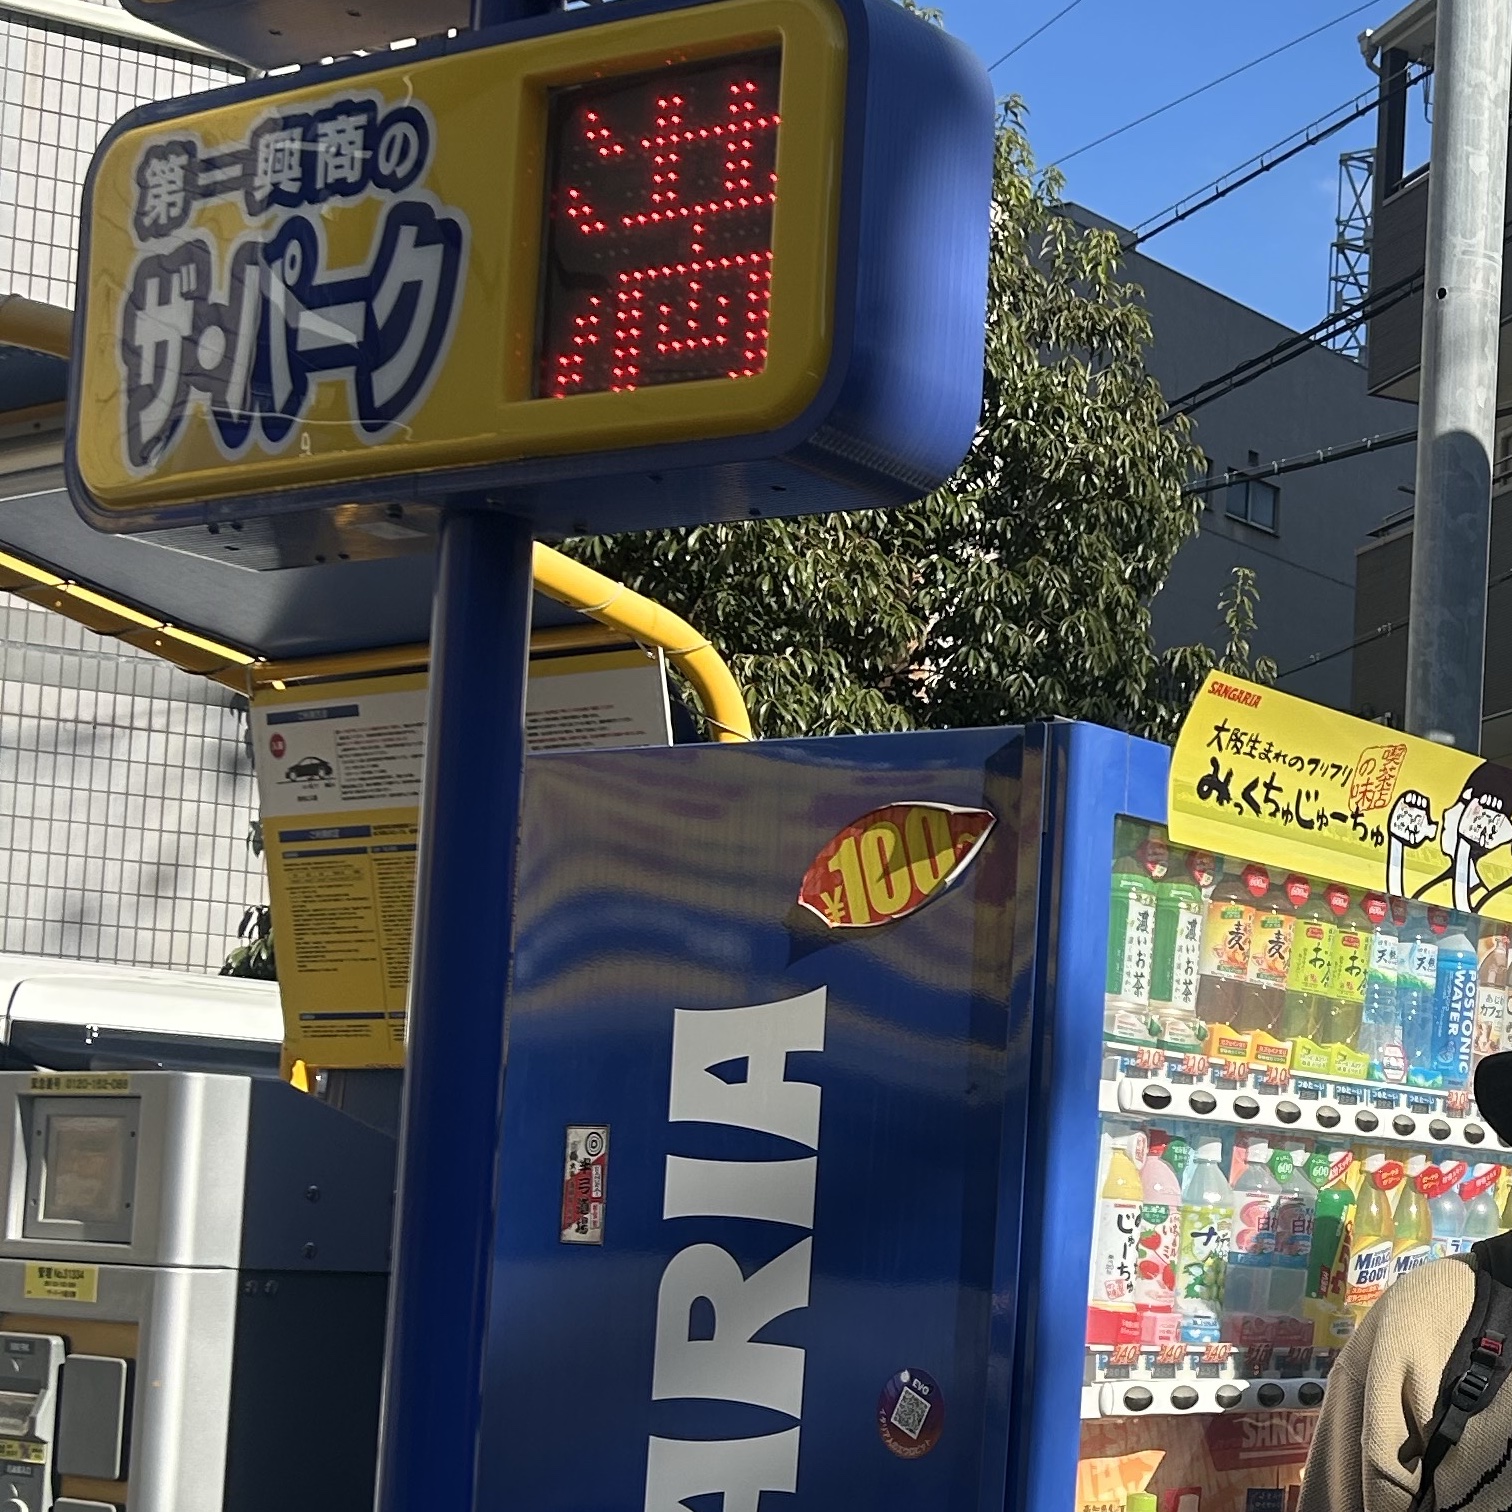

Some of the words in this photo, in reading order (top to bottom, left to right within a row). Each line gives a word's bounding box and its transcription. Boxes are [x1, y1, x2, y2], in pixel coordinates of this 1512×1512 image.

[141, 112, 421, 228] 第一興商の
[134, 225, 443, 443] ザ・パーク
[1207, 680, 1263, 709] SANGARIA
[1206, 718, 1354, 788] 大阪生まれのフリフリ
[1352, 757, 1376, 809] の味
[1373, 746, 1408, 808] 喫茶店
[1196, 756, 1386, 848] みっくちゅじゅーちゅ
[1447, 969, 1466, 1037] WATER
[1458, 969, 1478, 1074] POSTONIC
[912, 1378, 930, 1396] EVO
